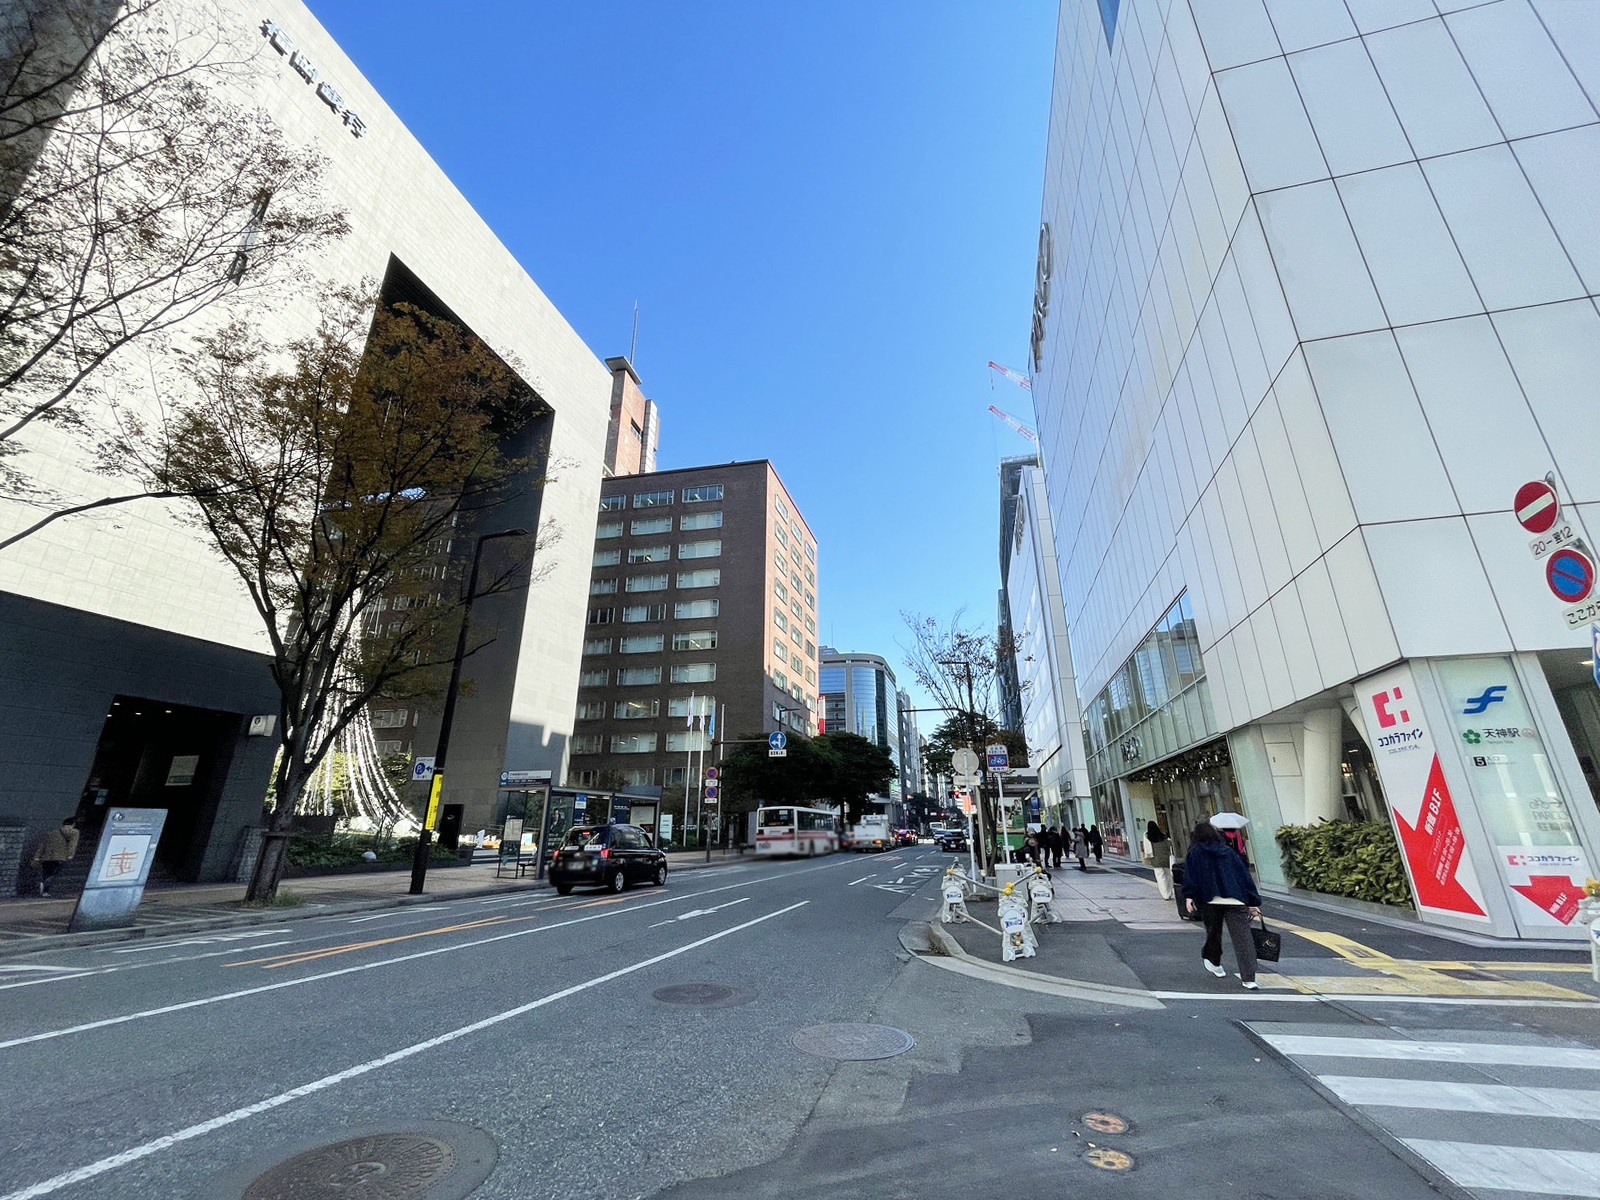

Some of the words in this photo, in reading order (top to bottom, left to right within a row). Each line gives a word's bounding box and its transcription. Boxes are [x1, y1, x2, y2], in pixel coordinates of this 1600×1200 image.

[1377, 728, 1423, 747] ココカラファイン
[1482, 727, 1521, 738] 天神駅
[1429, 788, 1442, 815] B1F
